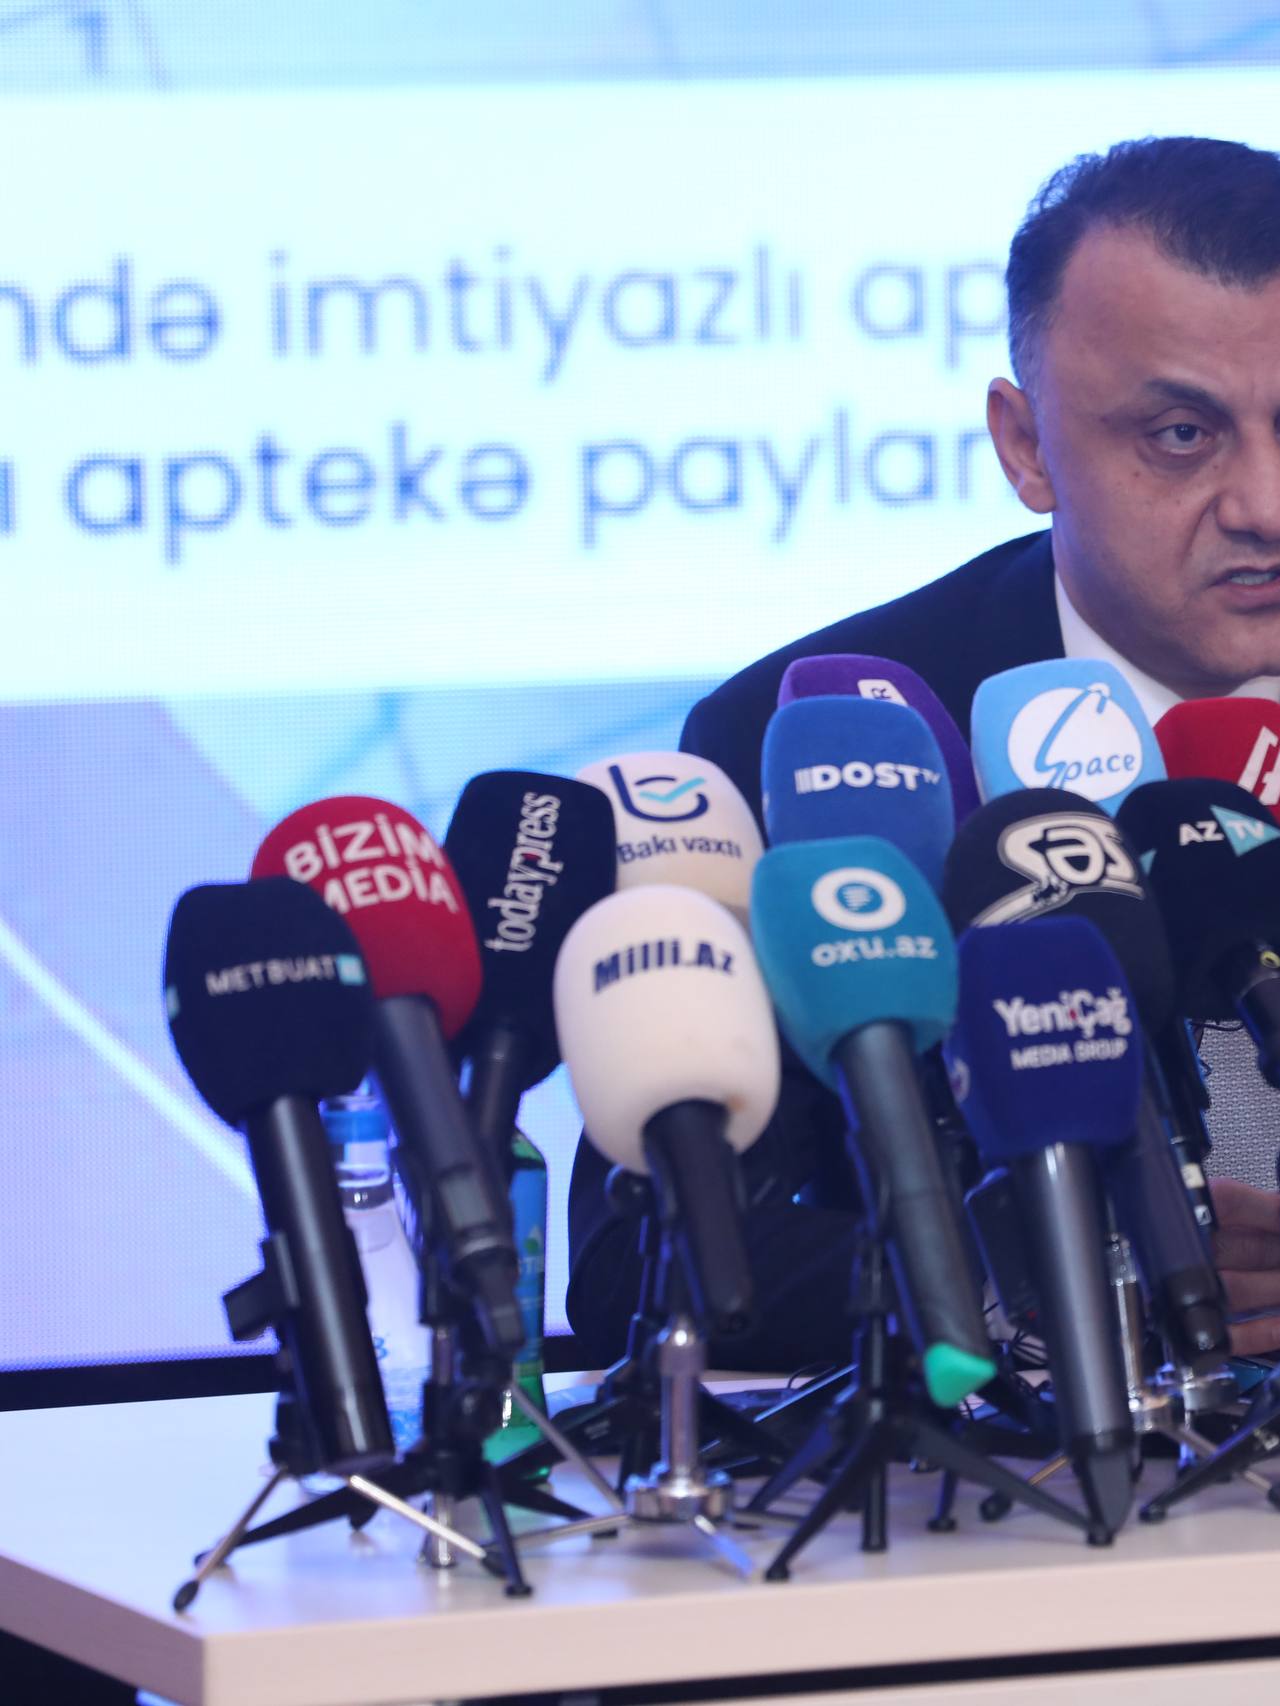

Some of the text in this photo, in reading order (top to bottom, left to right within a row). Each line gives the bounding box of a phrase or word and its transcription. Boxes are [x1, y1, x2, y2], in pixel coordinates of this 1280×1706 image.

[270, 241, 802, 386] imtiyazlı
[63, 420, 530, 565] aptekə
[284, 812, 447, 884] BİZİM
[484, 792, 564, 953] todaypress
[205, 955, 337, 996] METBUAT
[593, 938, 735, 994] Milli.Az
[811, 935, 938, 967] oxu.az
